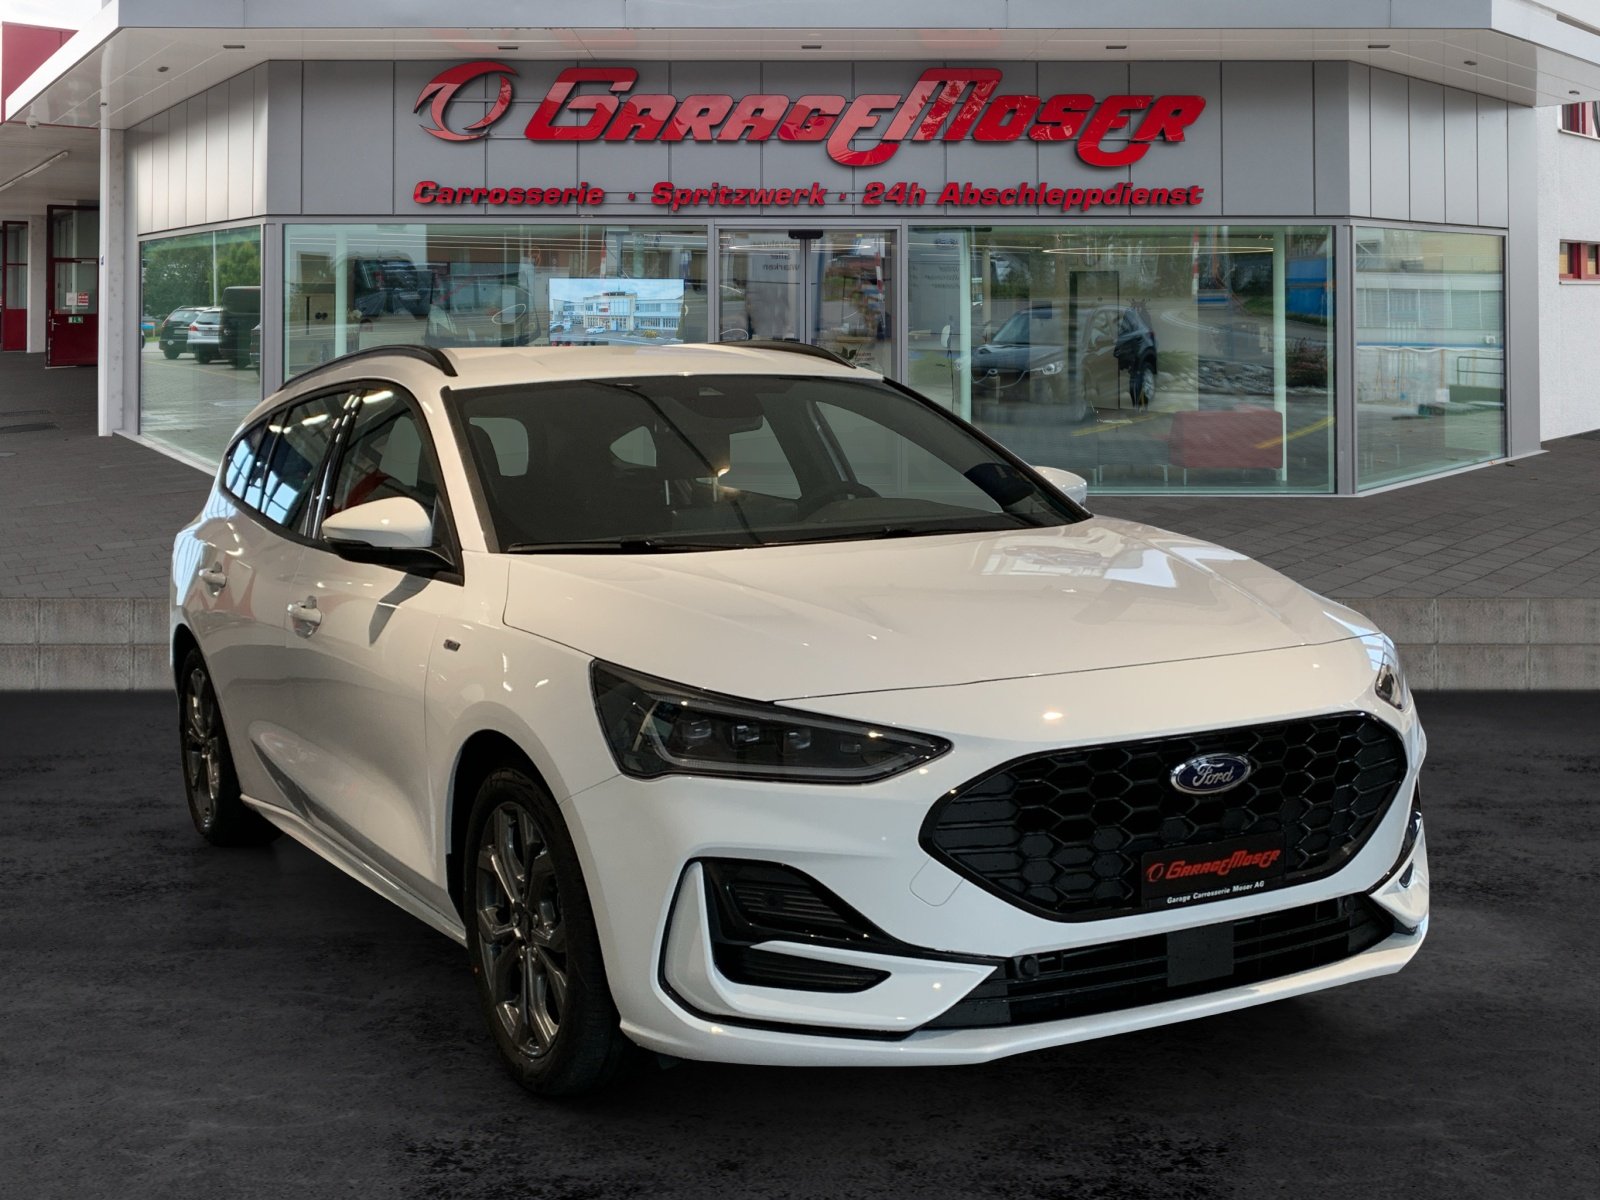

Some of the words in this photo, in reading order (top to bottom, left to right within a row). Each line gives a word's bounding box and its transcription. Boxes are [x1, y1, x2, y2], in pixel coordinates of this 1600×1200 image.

[413, 181, 604, 206] Carrosserie
[651, 181, 826, 211] Spritzwerk
[862, 182, 926, 206] 24h
[937, 181, 1205, 211] Abschleppdienst
[1192, 762, 1234, 787] Ford
[1166, 894, 1191, 904] Garage
[1192, 887, 1231, 900] Carrosserie
[1232, 882, 1253, 893] Moser
[1253, 880, 1265, 889] AG
